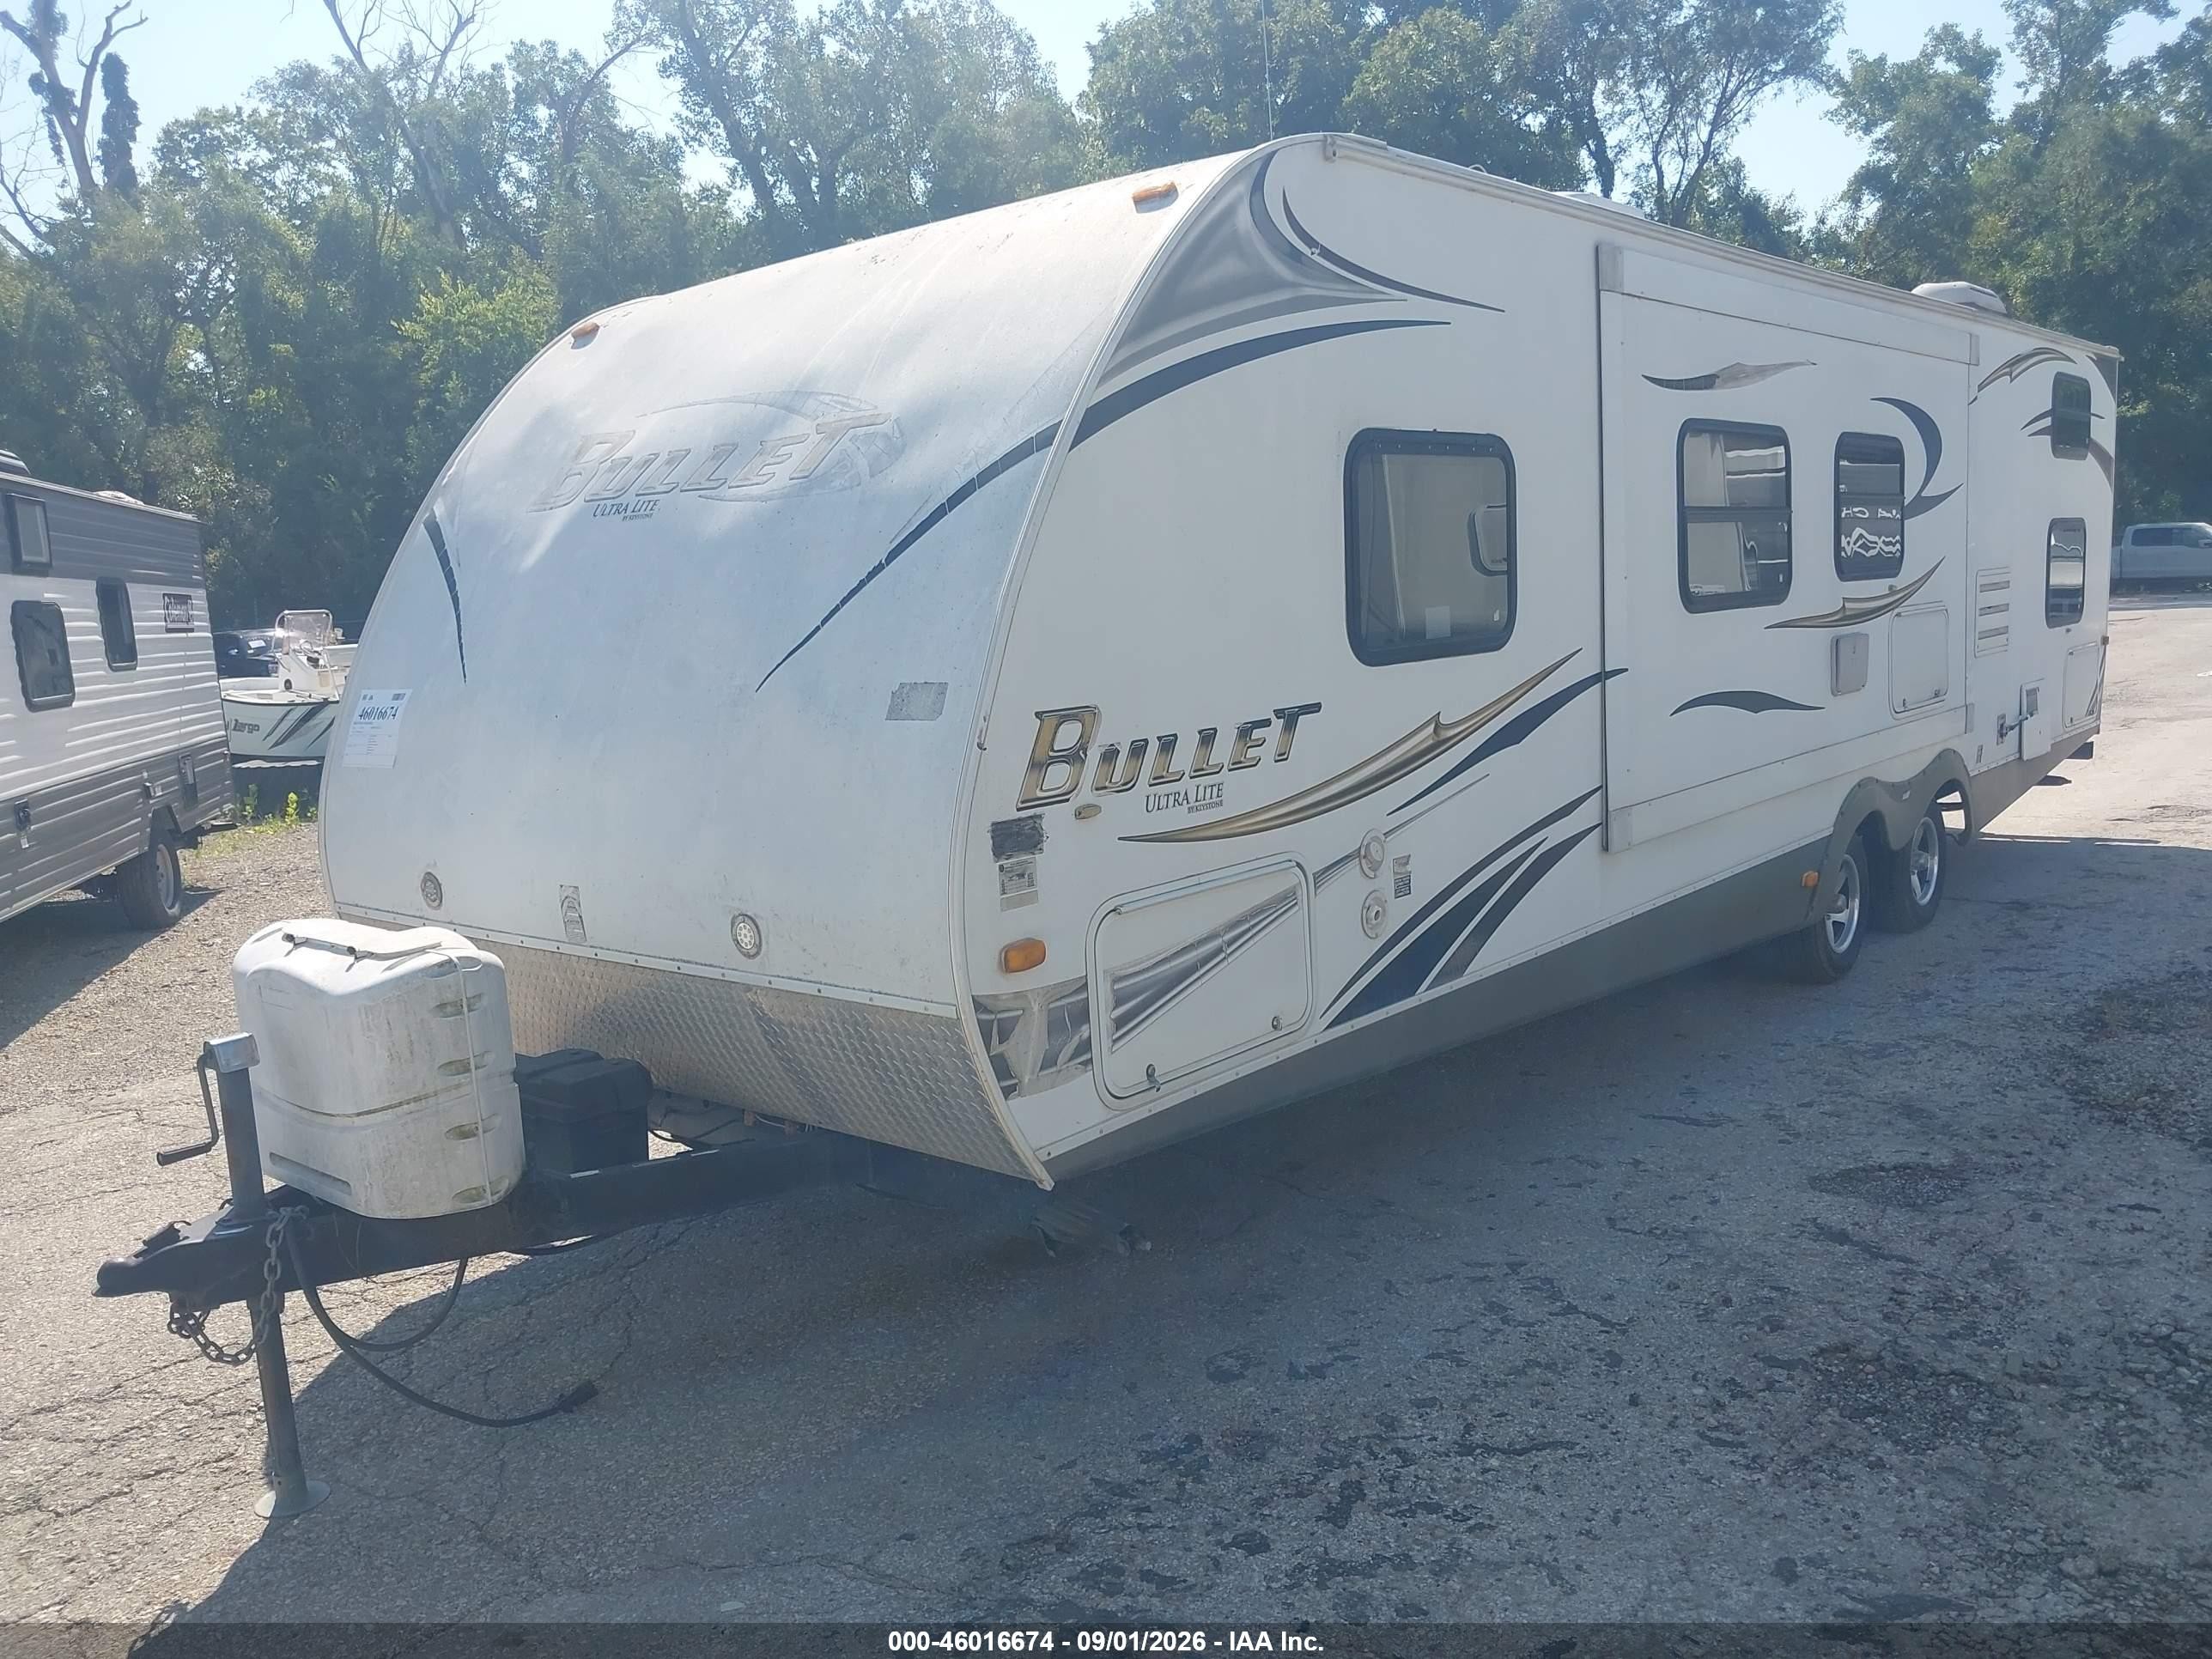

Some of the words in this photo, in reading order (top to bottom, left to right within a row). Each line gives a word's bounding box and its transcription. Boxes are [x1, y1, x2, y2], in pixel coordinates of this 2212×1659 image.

[526, 413, 893, 513] BULLET
[593, 502, 629, 517] ULTRA
[631, 499, 659, 513] LITE
[358, 706, 399, 720] 46016674
[1016, 702, 1322, 811] BULLET
[1146, 789, 1190, 813] ULTRA
[1194, 782, 1224, 803] LITE
[1195, 799, 1224, 812] KEYSTONE
